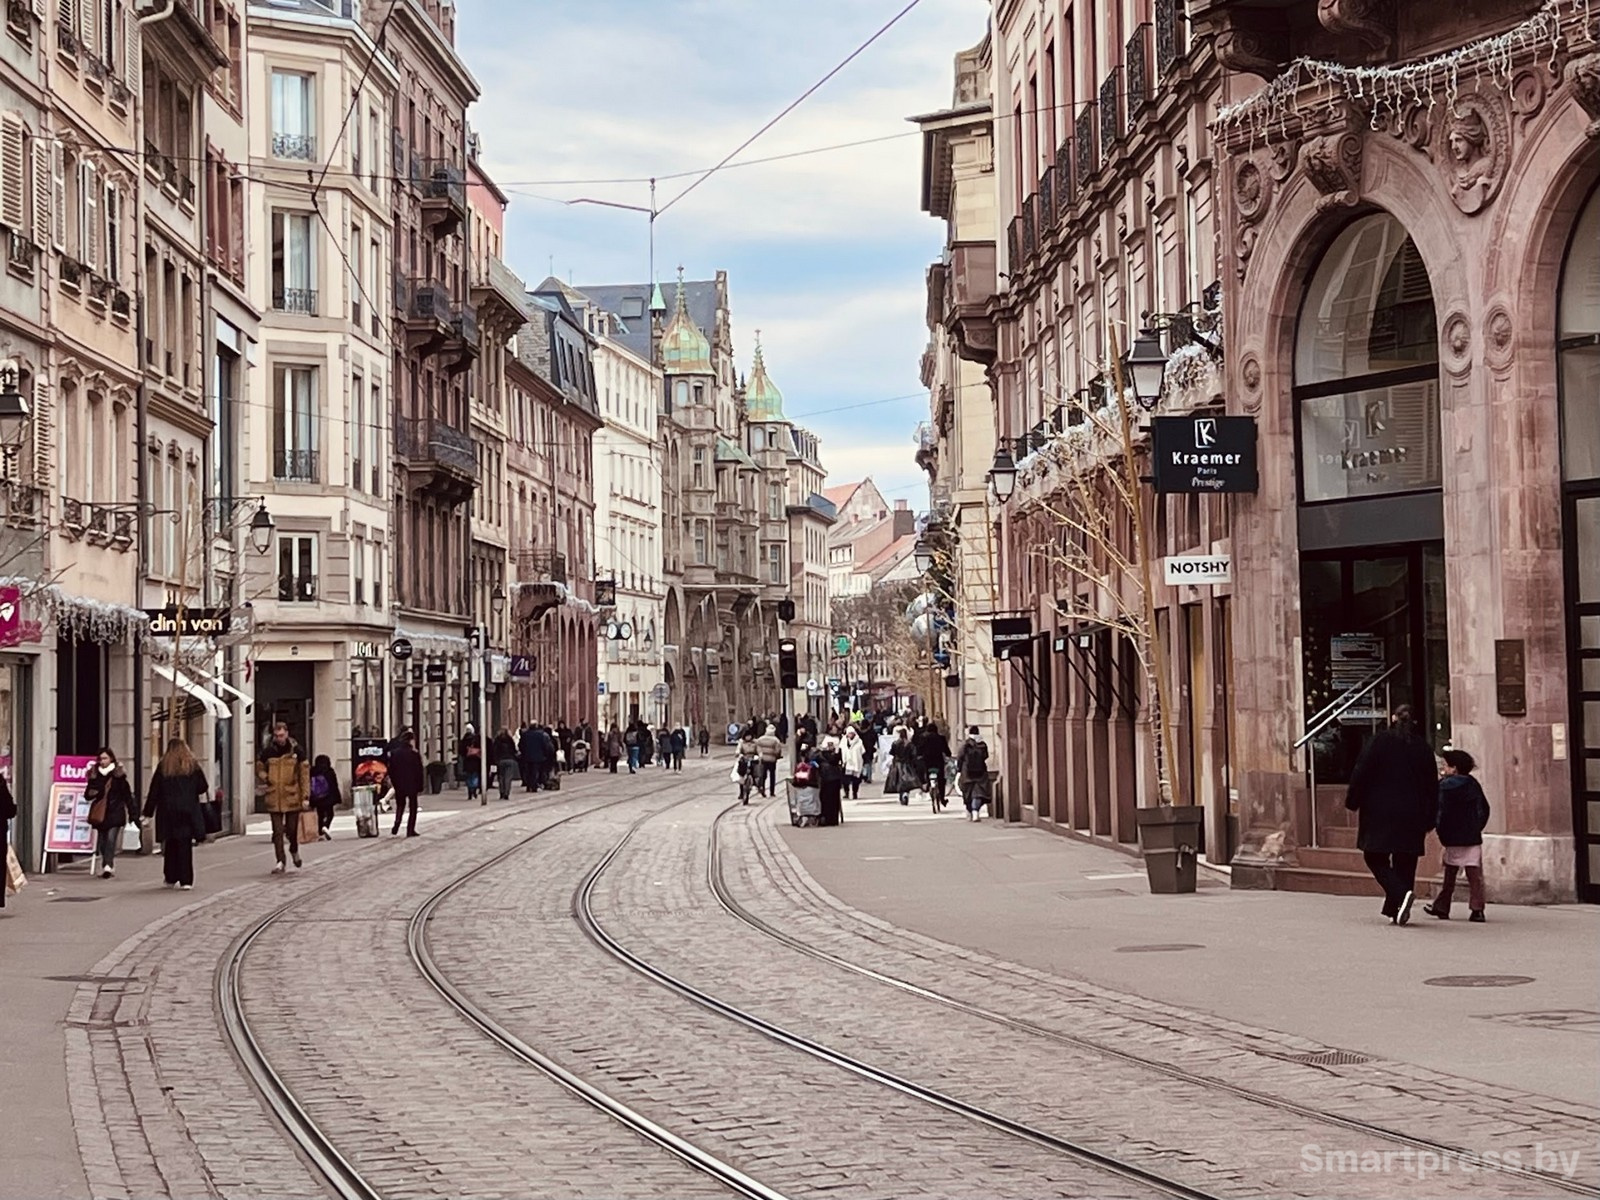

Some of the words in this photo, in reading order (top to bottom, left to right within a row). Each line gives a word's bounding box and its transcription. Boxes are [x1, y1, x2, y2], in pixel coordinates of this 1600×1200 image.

[1198, 420, 1217, 447] K
[1172, 451, 1241, 465] Kraemer
[1197, 467, 1217, 475] Paris
[1170, 561, 1230, 574] NOTSHY
[191, 619, 223, 632] van
